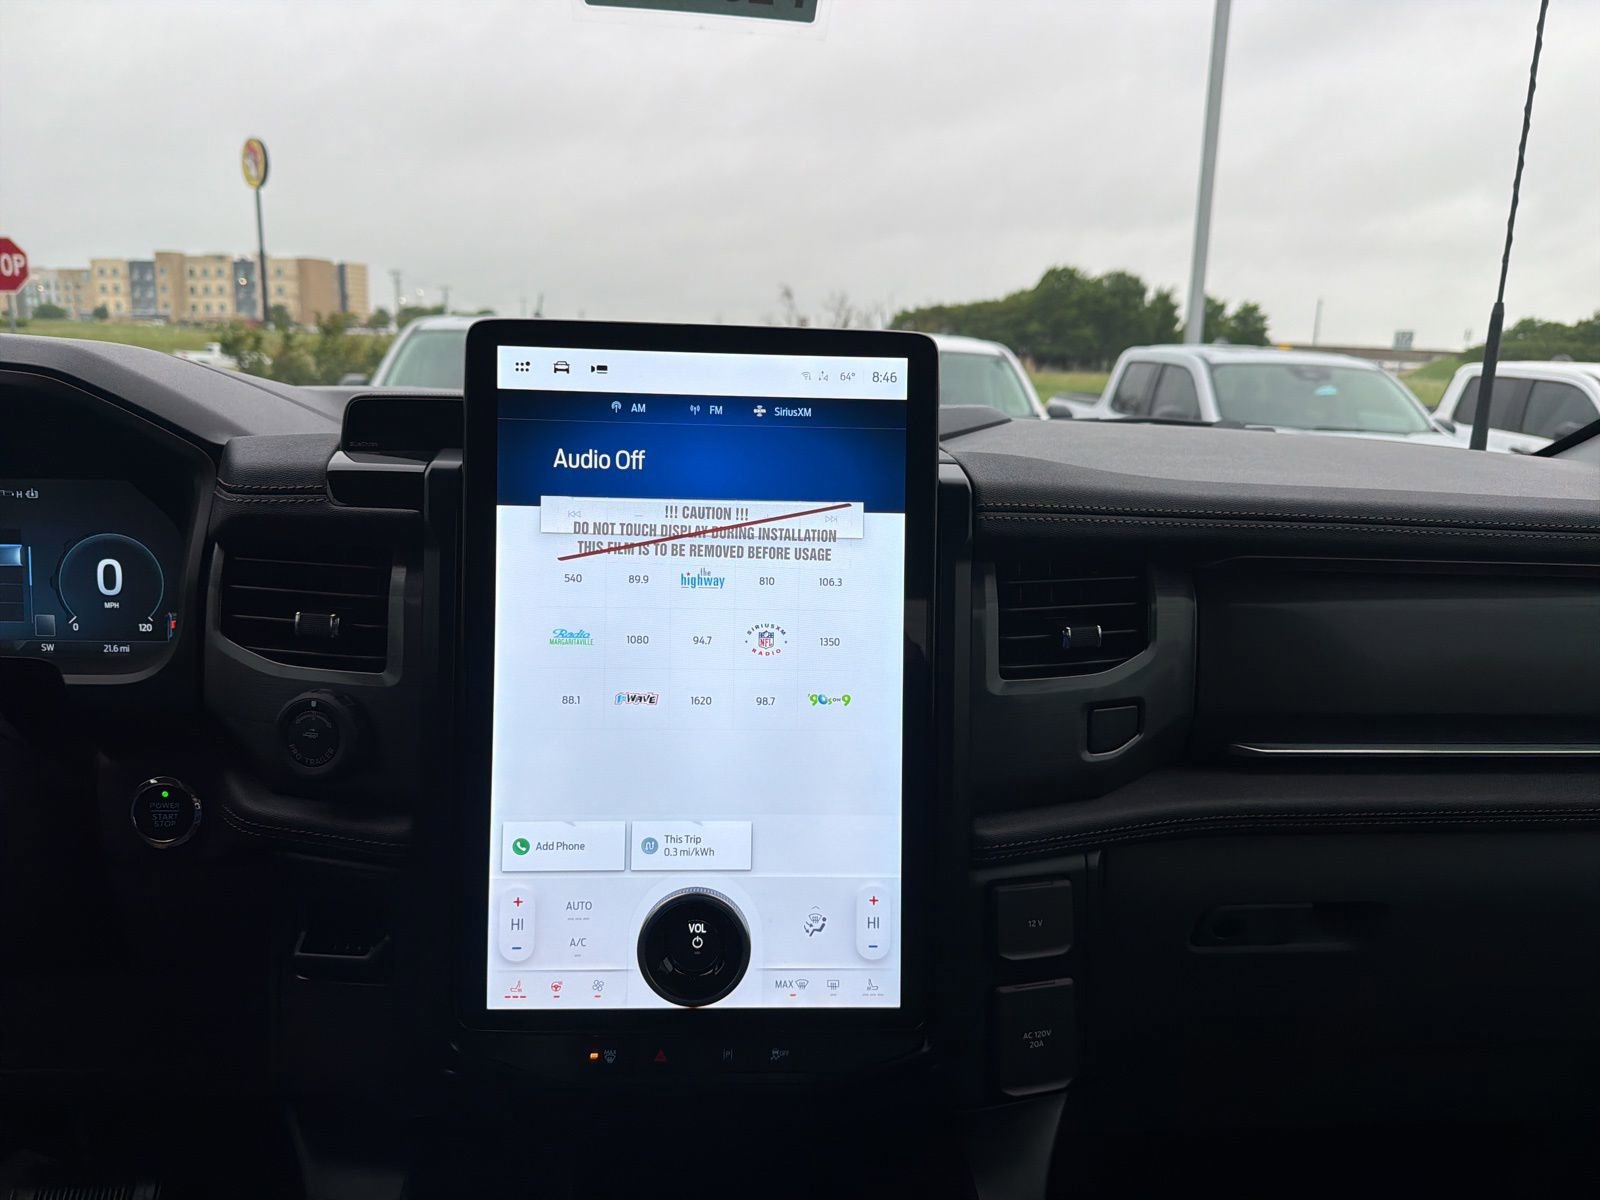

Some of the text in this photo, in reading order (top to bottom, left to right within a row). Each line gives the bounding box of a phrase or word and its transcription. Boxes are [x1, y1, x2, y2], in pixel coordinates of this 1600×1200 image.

[840, 371, 855, 382] 64°
[872, 371, 897, 383] 8:46
[631, 402, 646, 414] AM
[709, 405, 723, 416] FM
[774, 406, 812, 419] SiriusXM
[553, 448, 646, 470] Audio Off
[665, 506, 749, 521] !!! CAUTION !!!
[573, 521, 837, 543] DO NOT TOUCH DISPLAY DURING INSTALLATION
[577, 541, 832, 561] THIS FILM IS TO BE REMOVED BEFORE USAGE
[96, 558, 123, 597] 0
[700, 567, 712, 577] the
[564, 573, 583, 584] 540
[628, 574, 650, 585] 89.9
[680, 571, 726, 590] highway
[758, 576, 776, 587] 810
[818, 577, 843, 588] 106.3
[104, 601, 120, 610] MPH
[72, 622, 79, 632] 0
[138, 623, 153, 633] 120
[746, 623, 787, 636] SIRIUSXM
[552, 628, 591, 639] Radio
[549, 638, 593, 646] MARGARITAVILLE
[626, 635, 650, 645] 1080
[692, 636, 713, 646] 94.7
[760, 638, 773, 647] NFL
[819, 637, 841, 647] 1350
[40, 643, 55, 652] SW
[103, 644, 130, 654] 21.6 mi
[751, 647, 782, 657] RADIO
[561, 695, 581, 706] 88.1
[690, 696, 713, 706] 1620
[755, 696, 776, 706] 98.7
[151, 813, 178, 821] START
[153, 820, 177, 828] STOP
[664, 834, 702, 847] This Trip
[536, 841, 585, 852] Add Phone
[664, 846, 715, 858] 0.3 mi/kWh
[565, 900, 593, 912] AUTO
[511, 918, 524, 931] HI
[867, 917, 880, 930] HI
[1028, 919, 1038, 927] 12
[688, 923, 707, 935] VOL
[569, 937, 587, 948] A/C
[775, 979, 794, 989] MAX
[1023, 1030, 1052, 1040] AC 120V
[1030, 1040, 1044, 1049] 20A
